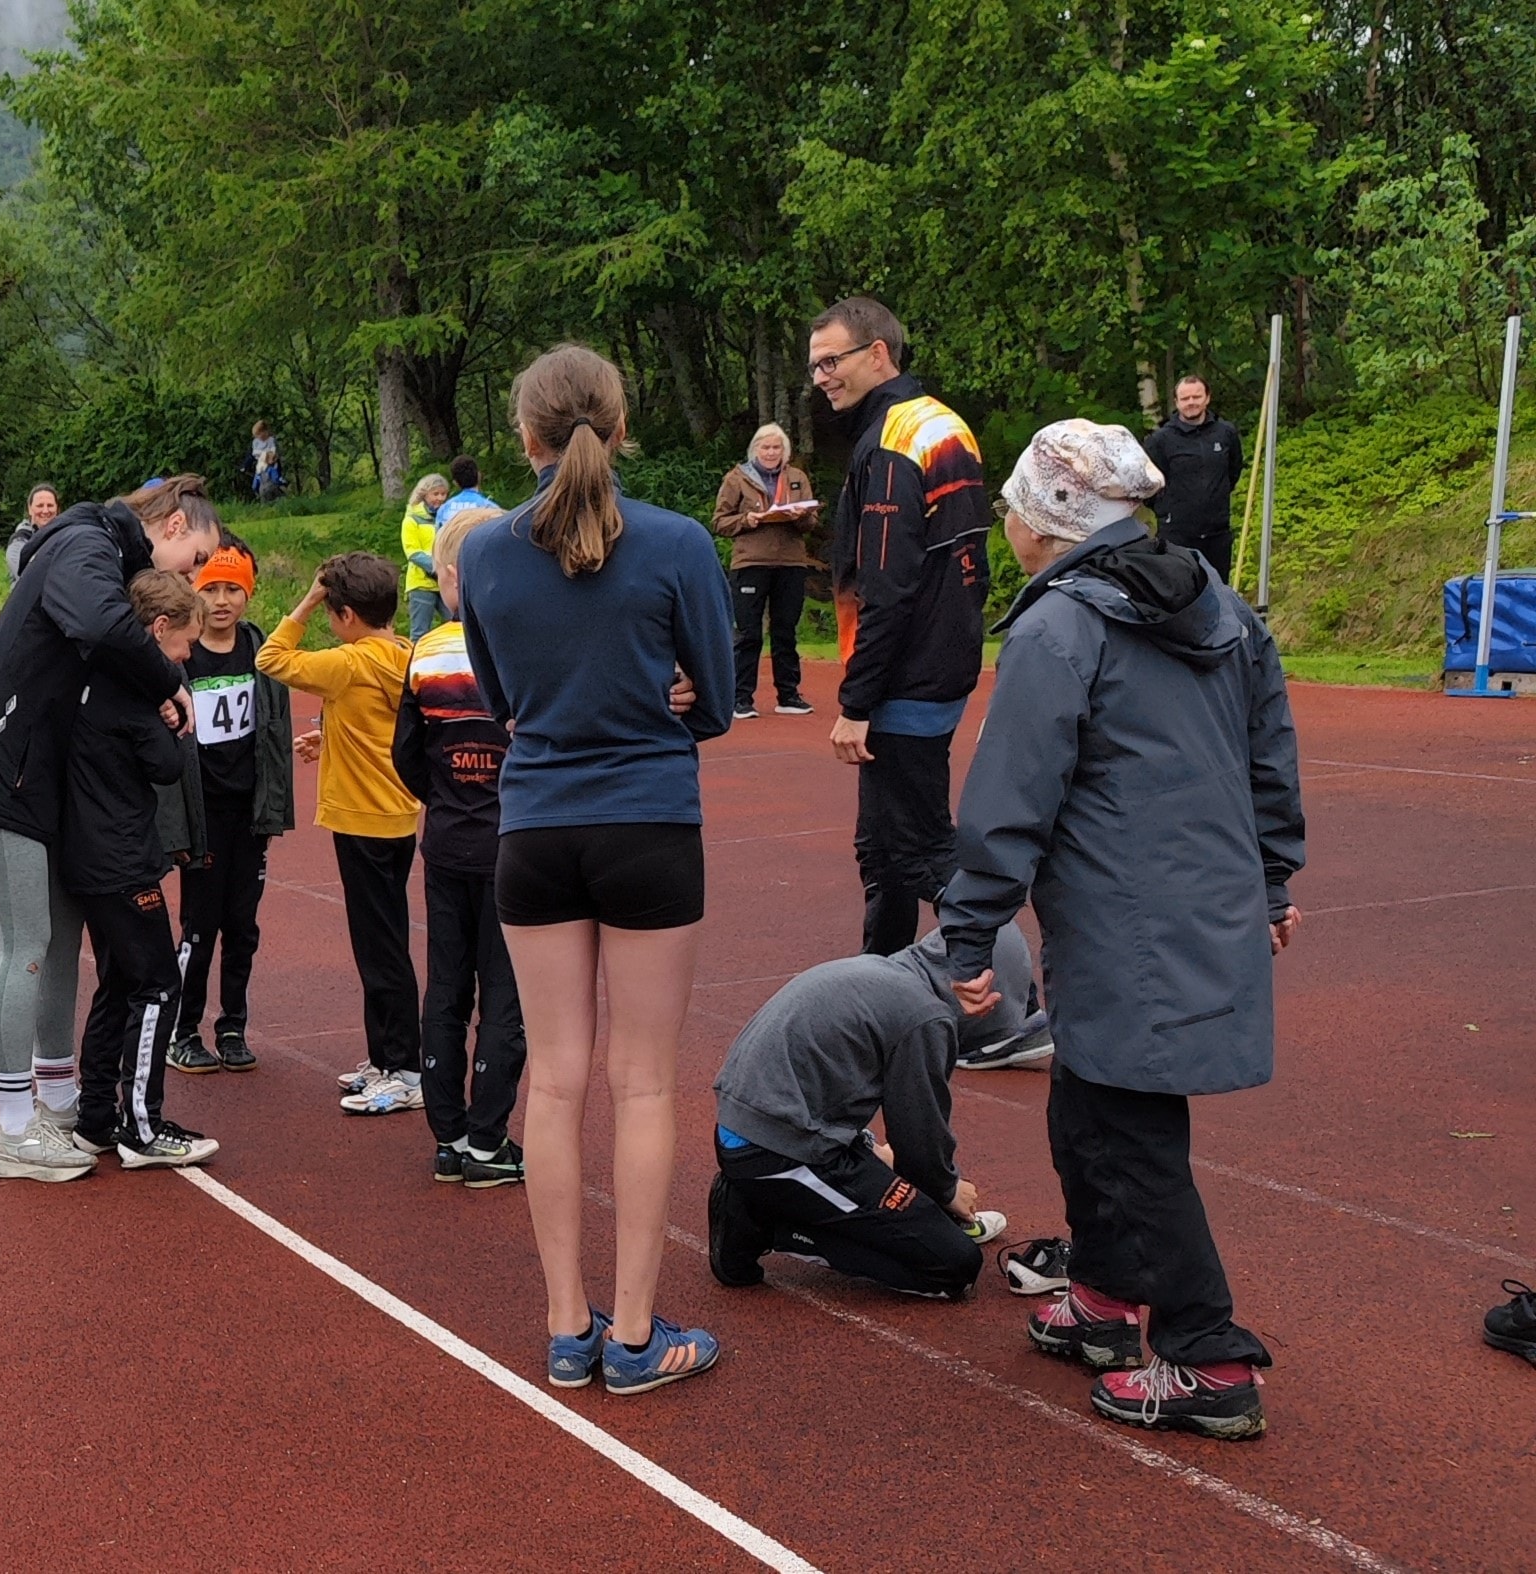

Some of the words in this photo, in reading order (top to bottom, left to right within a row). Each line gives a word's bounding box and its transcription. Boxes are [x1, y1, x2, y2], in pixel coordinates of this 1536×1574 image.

[214, 556, 239, 565] SMIL
[212, 690, 250, 733] 42
[451, 752, 497, 769] SMIL
[137, 892, 161, 906] SMIL
[885, 1182, 910, 1210] SMIL
